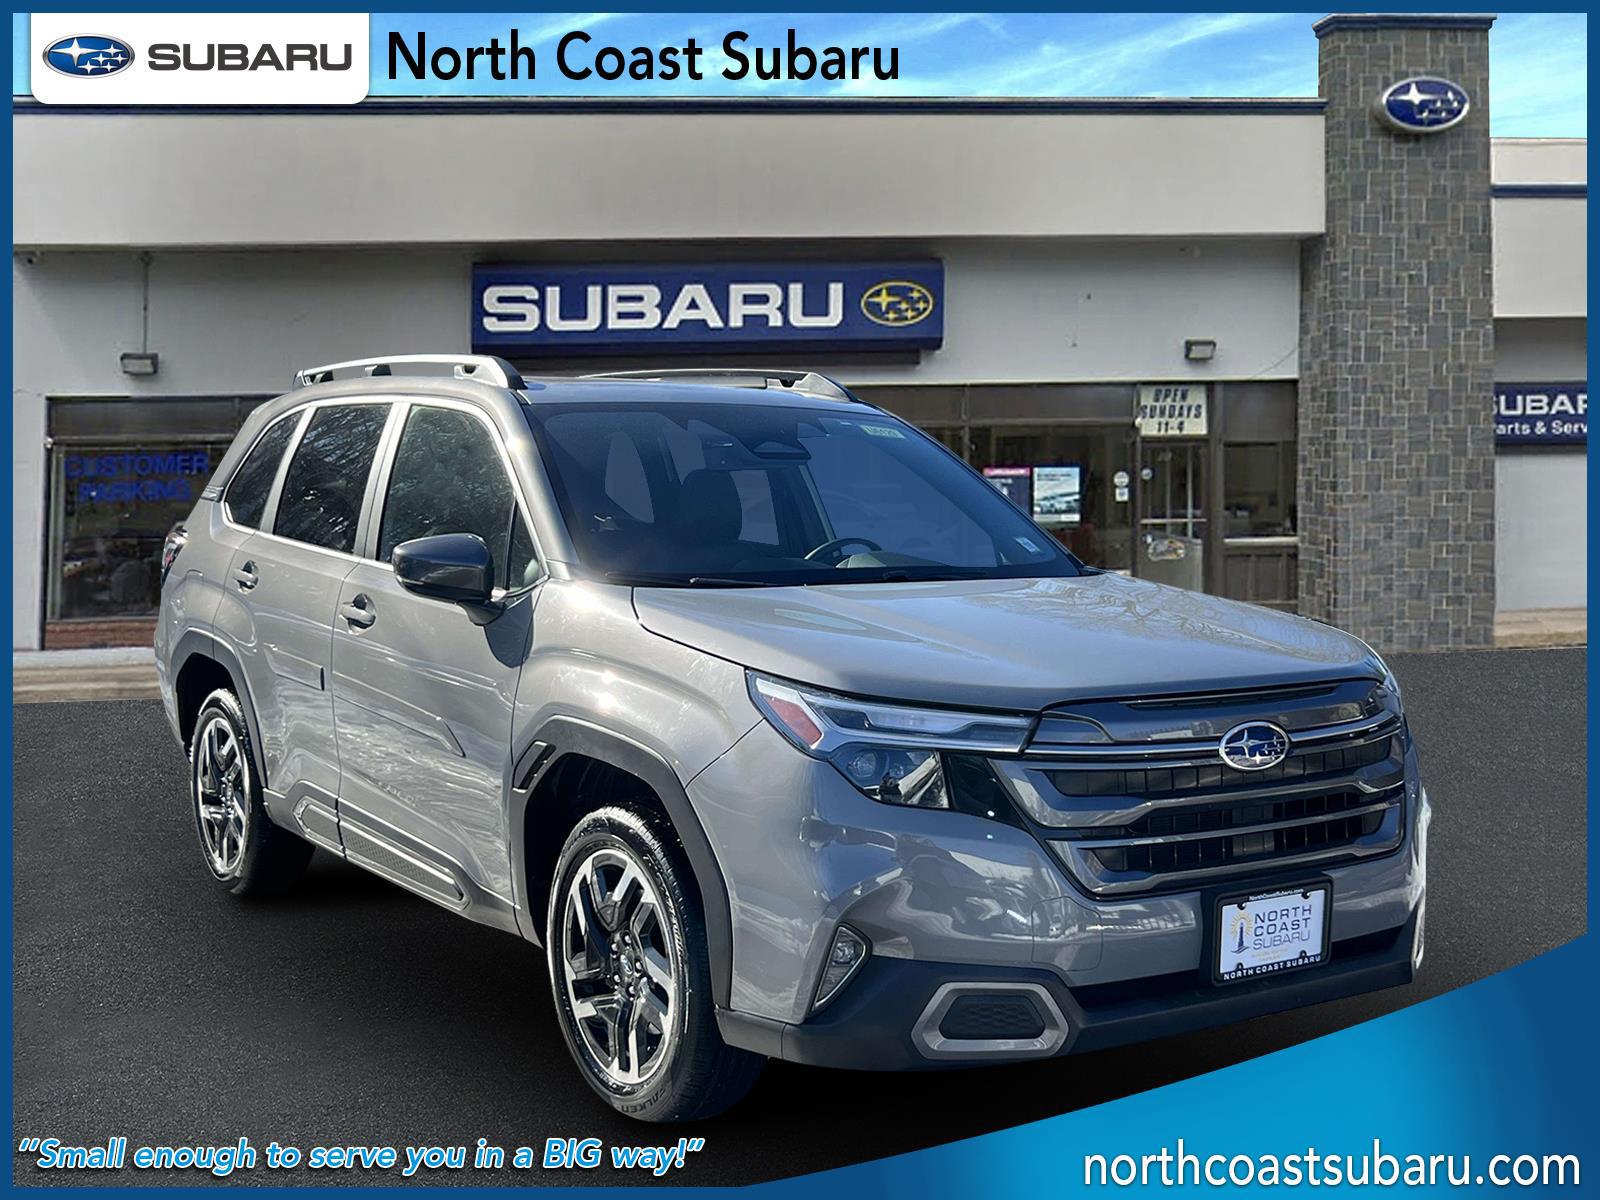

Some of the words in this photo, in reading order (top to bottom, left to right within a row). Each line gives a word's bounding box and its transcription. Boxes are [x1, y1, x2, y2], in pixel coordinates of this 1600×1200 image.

[482, 281, 844, 332] SUBARU
[1153, 388, 1190, 403] OPEN
[1493, 394, 1587, 415] UBA
[1140, 404, 1203, 420] SUNDAYS
[1534, 420, 1547, 435] &
[64, 452, 209, 478] CUSTOMER
[78, 479, 191, 504] PARKING
[1254, 904, 1312, 925] NORTH
[1254, 917, 1311, 937] COAST
[1252, 930, 1311, 951] SUBARU
[1223, 968, 1254, 981] NORTH
[1255, 962, 1284, 975] COAST
[1286, 955, 1321, 968] SUBARU
